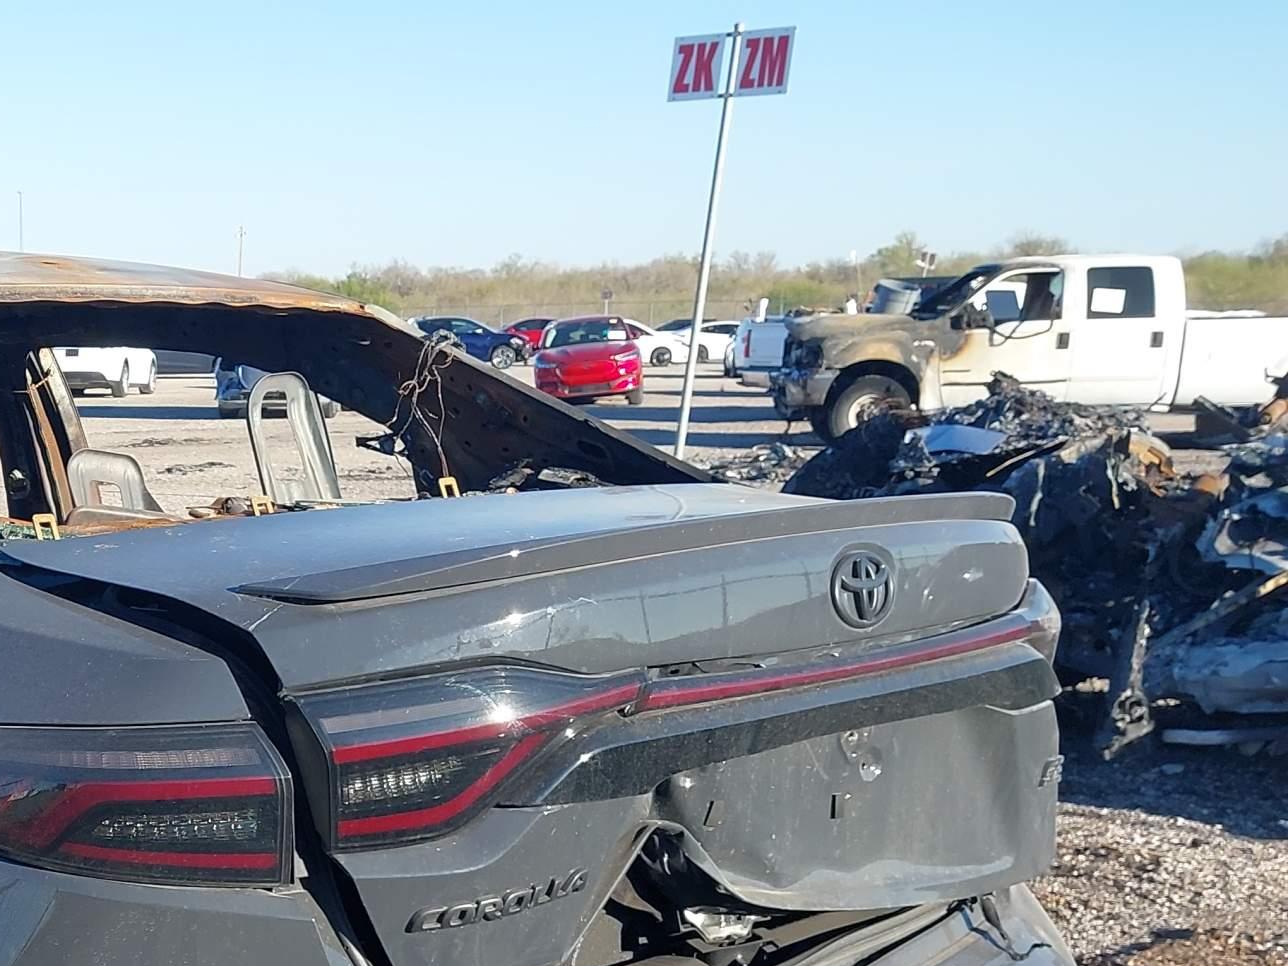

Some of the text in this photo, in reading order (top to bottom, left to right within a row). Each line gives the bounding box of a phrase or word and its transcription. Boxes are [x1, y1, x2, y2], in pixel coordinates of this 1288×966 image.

[672, 41, 720, 94] ZK
[739, 35, 790, 90] ZM
[404, 866, 589, 934] COROLLA
